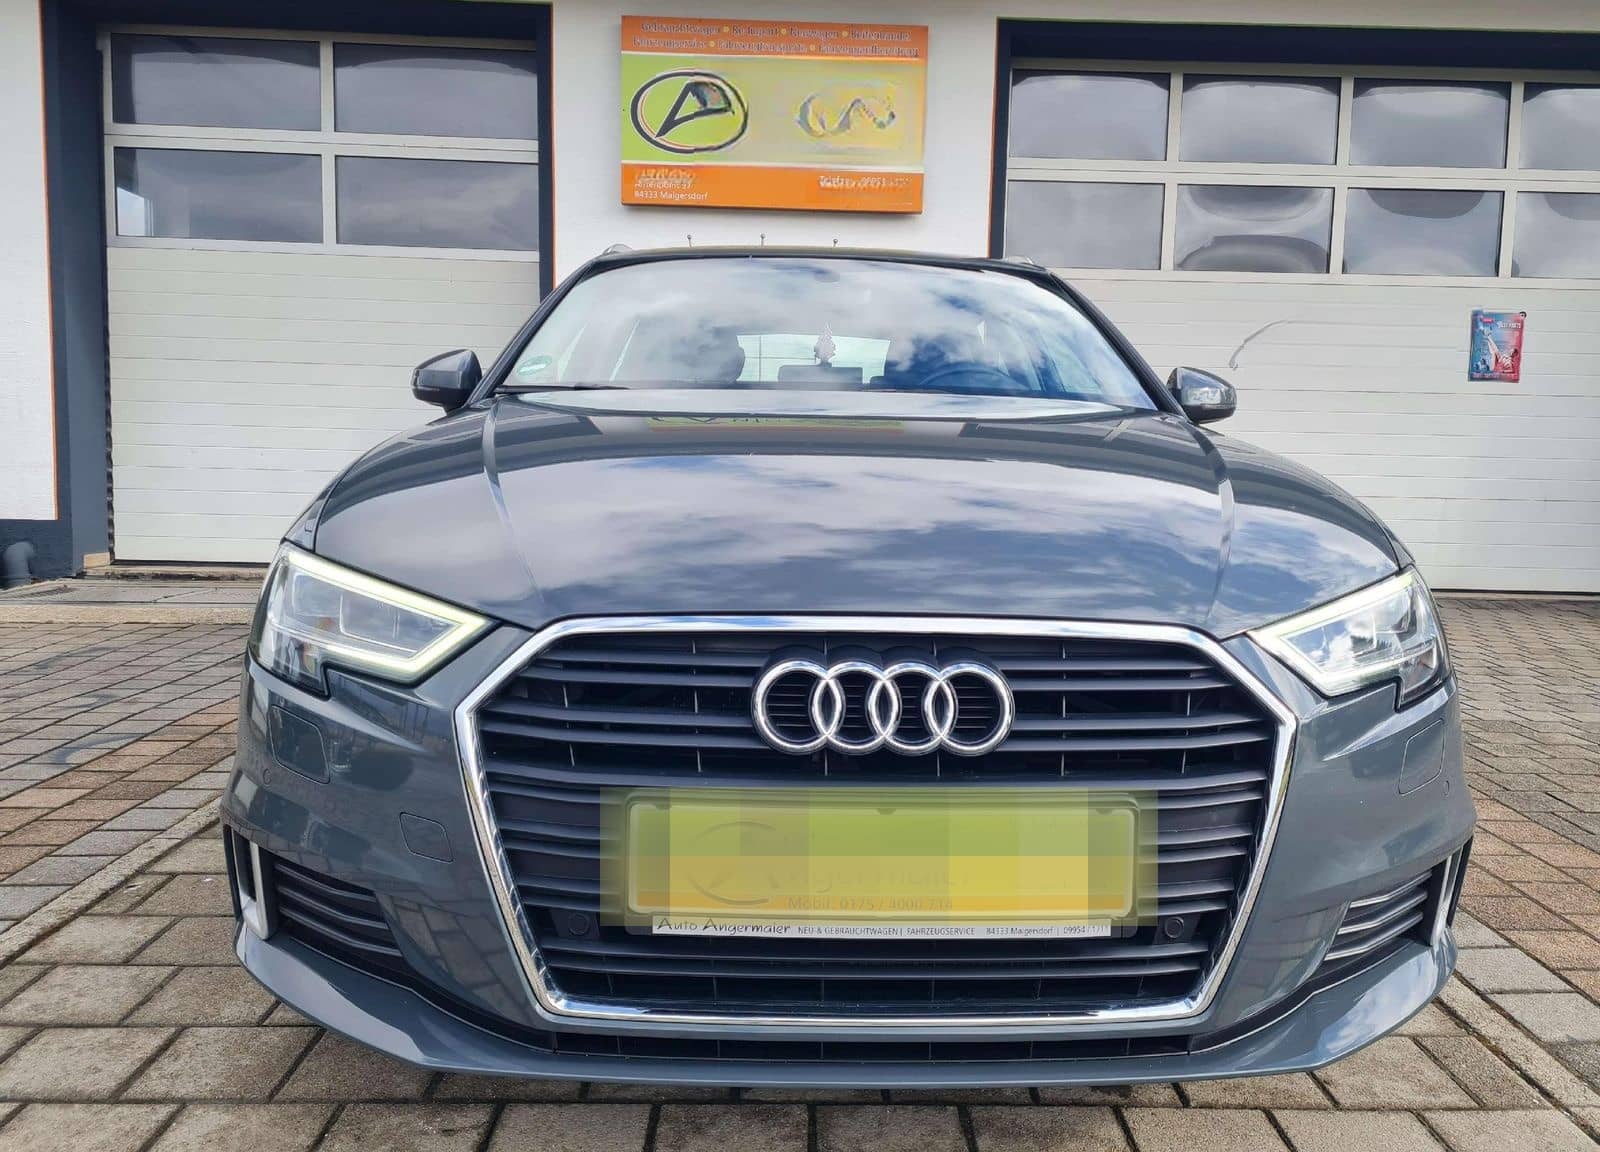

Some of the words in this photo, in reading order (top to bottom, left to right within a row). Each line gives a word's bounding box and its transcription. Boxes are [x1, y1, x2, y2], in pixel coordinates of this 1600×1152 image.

[656, 917, 697, 931] Auto
[702, 917, 791, 935] Angermaier
[825, 927, 898, 936] GEBRAUCHTWAGEN
[907, 928, 975, 936] FAHRZEUGSERVICE
